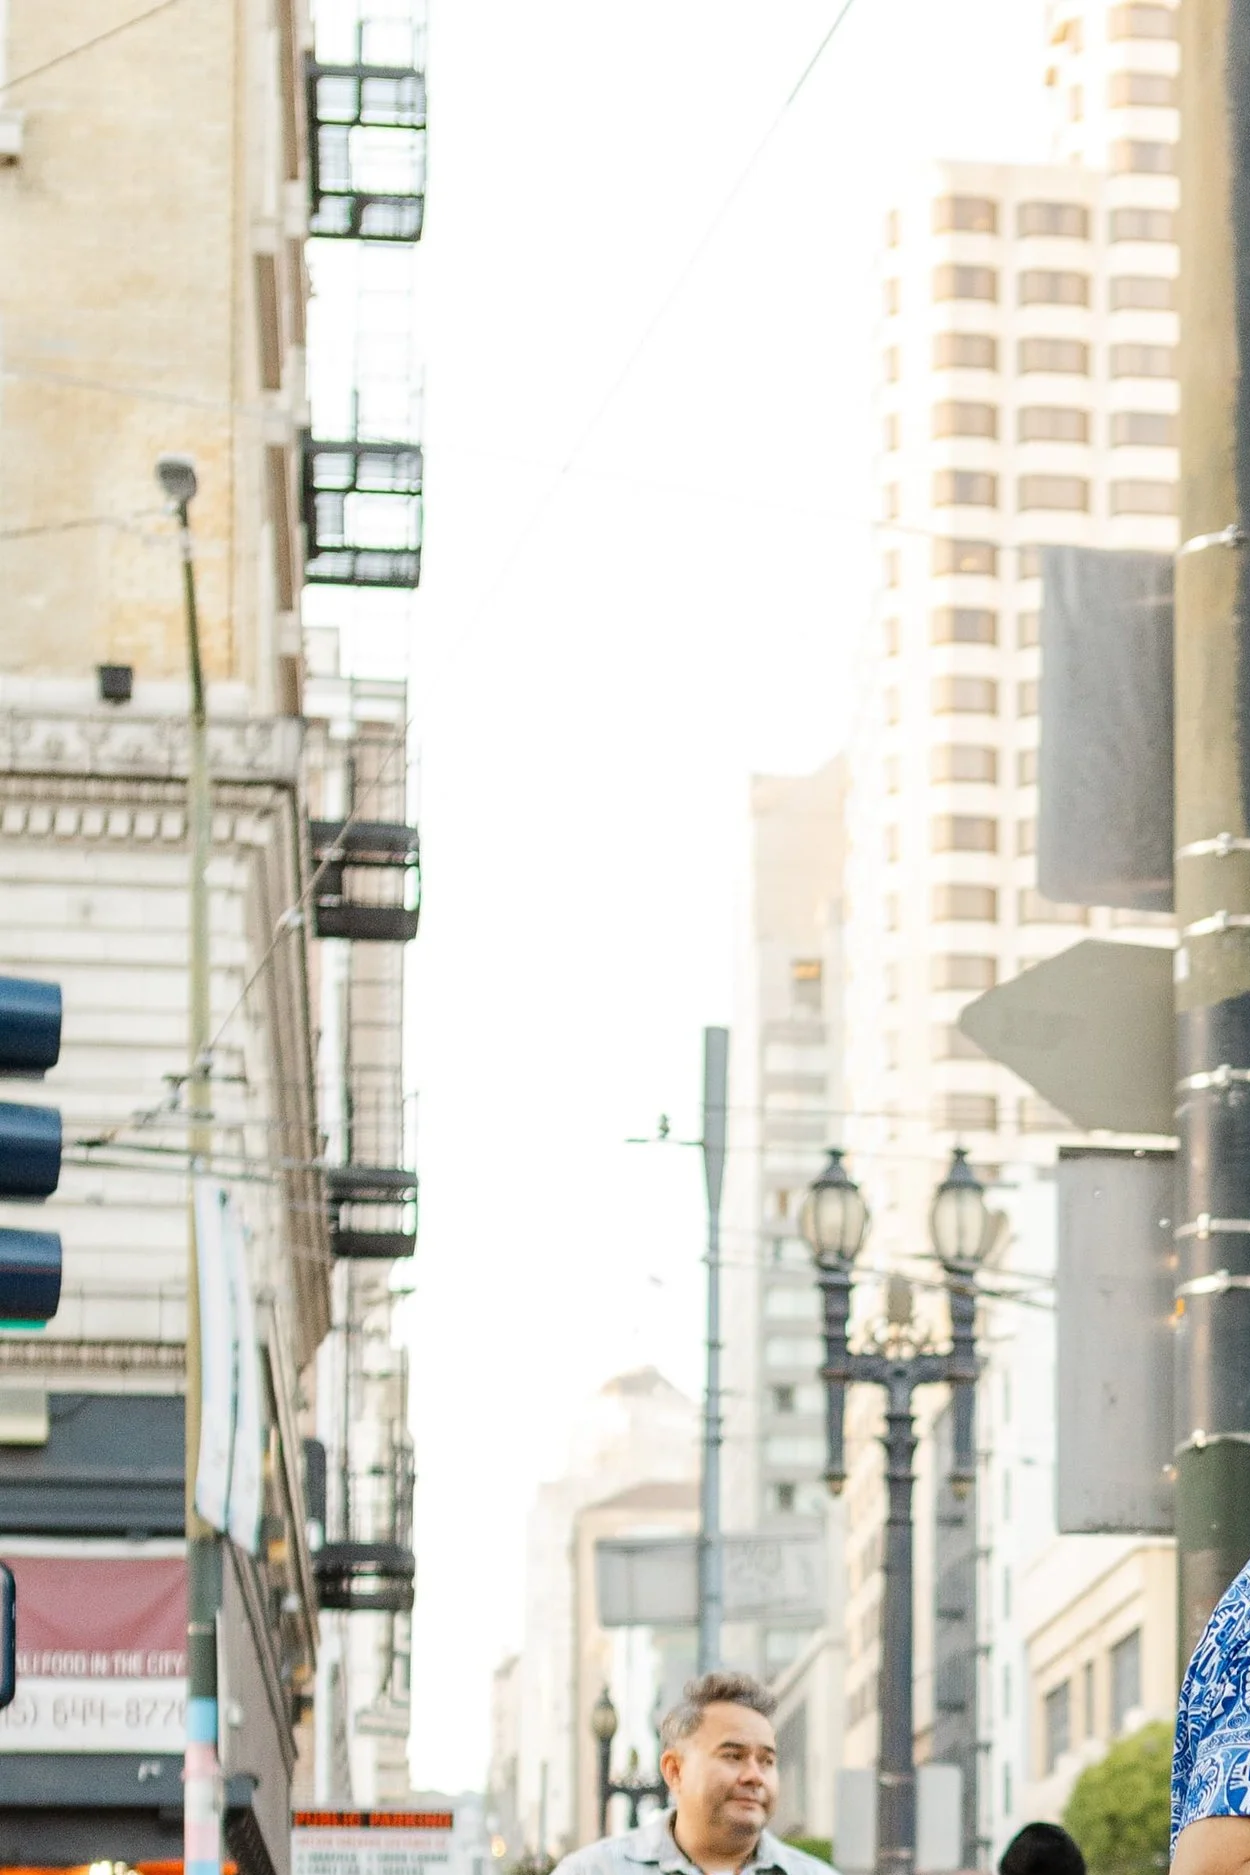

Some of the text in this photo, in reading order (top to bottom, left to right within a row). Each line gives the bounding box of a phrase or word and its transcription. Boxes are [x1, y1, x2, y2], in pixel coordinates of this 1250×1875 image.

[42, 1653, 87, 1676] FOOD
[113, 1653, 144, 1676] THE
[146, 1653, 184, 1676] CITY
